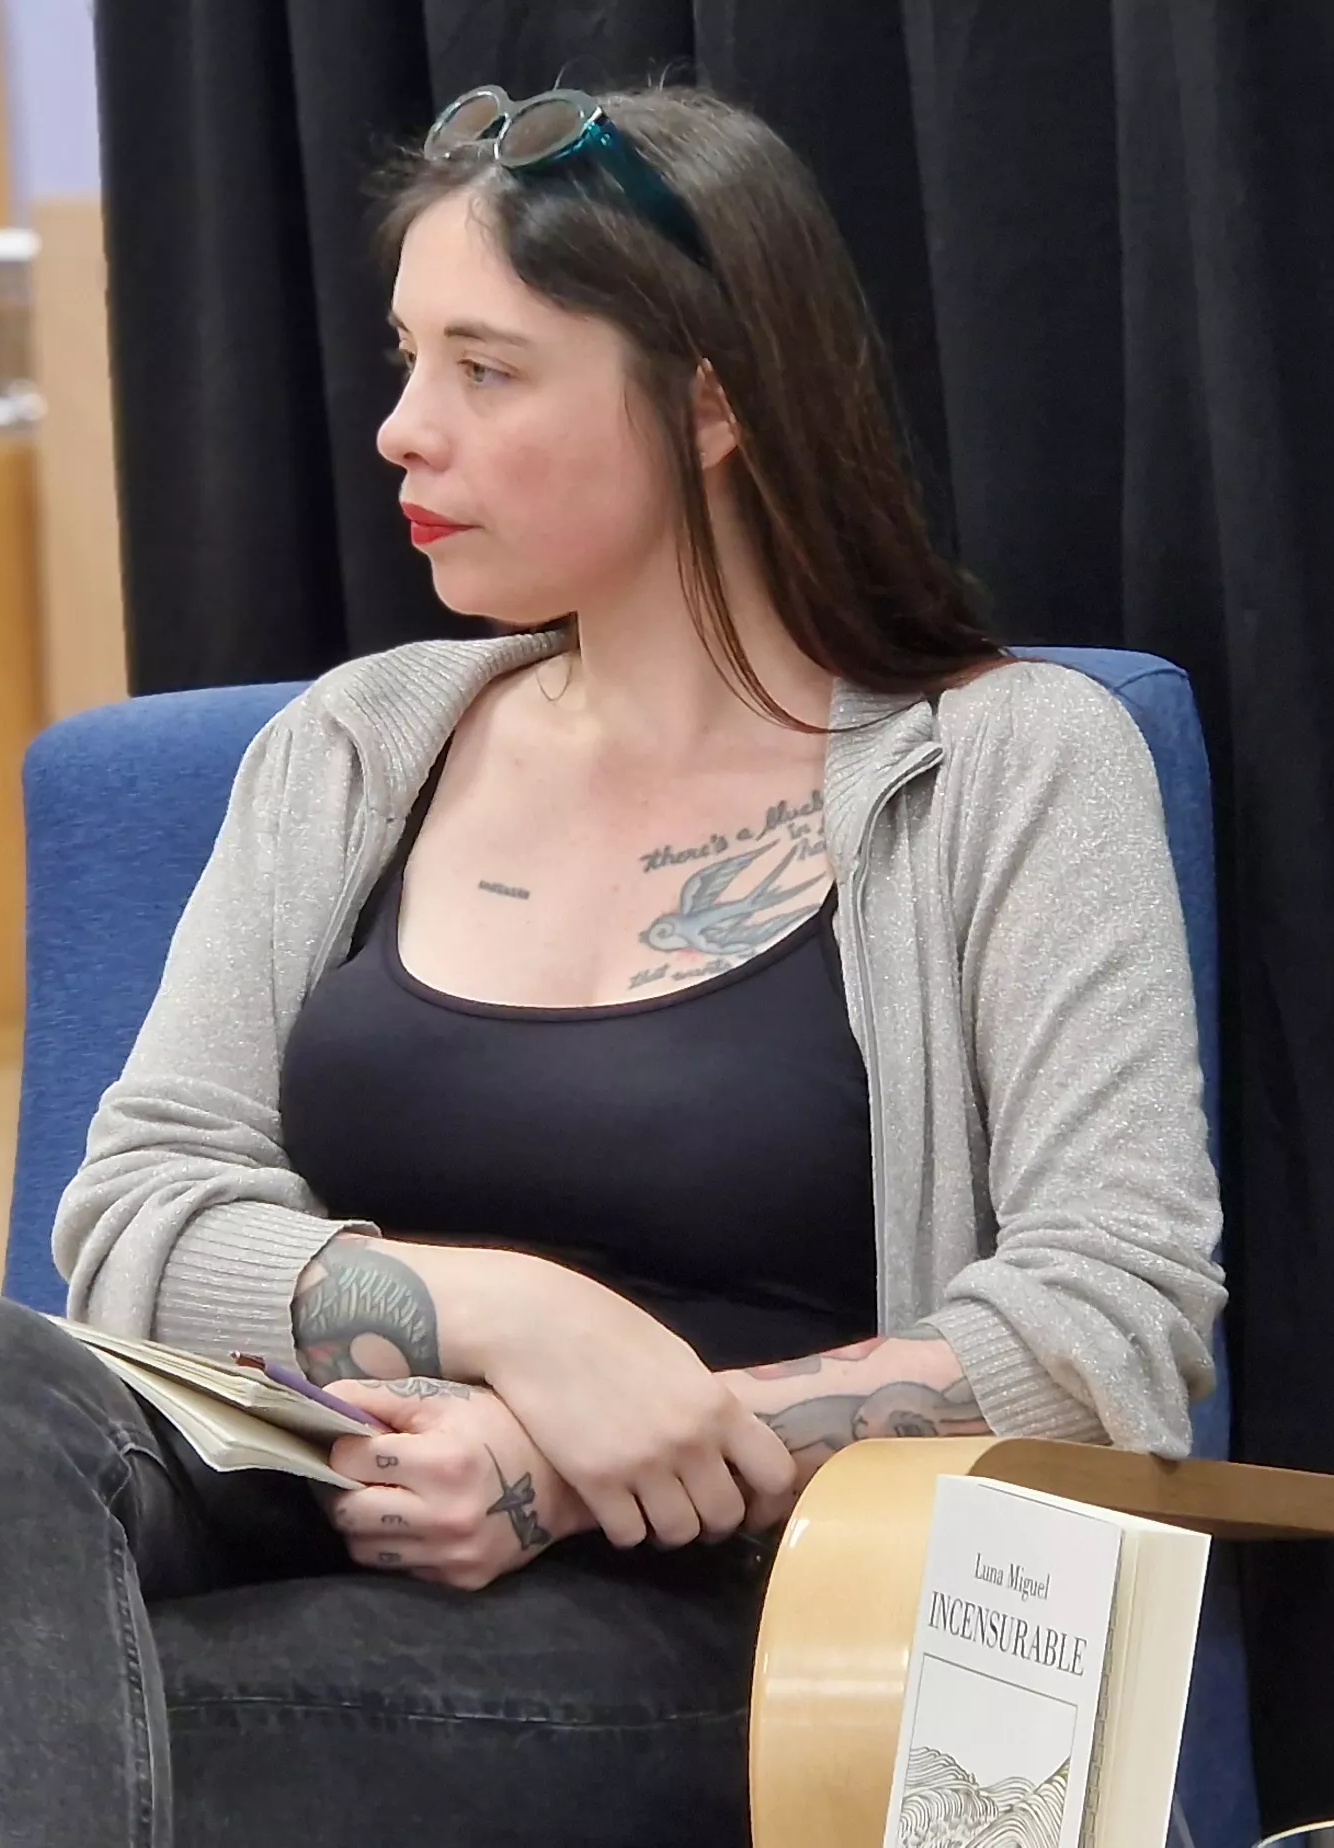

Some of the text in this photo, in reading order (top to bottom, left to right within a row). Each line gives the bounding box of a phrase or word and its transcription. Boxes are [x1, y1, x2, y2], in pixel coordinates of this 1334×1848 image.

[735, 827, 754, 841] a
[973, 1551, 1051, 1603] Luna Miguel
[927, 1589, 1088, 1678] INCENSURABLE
